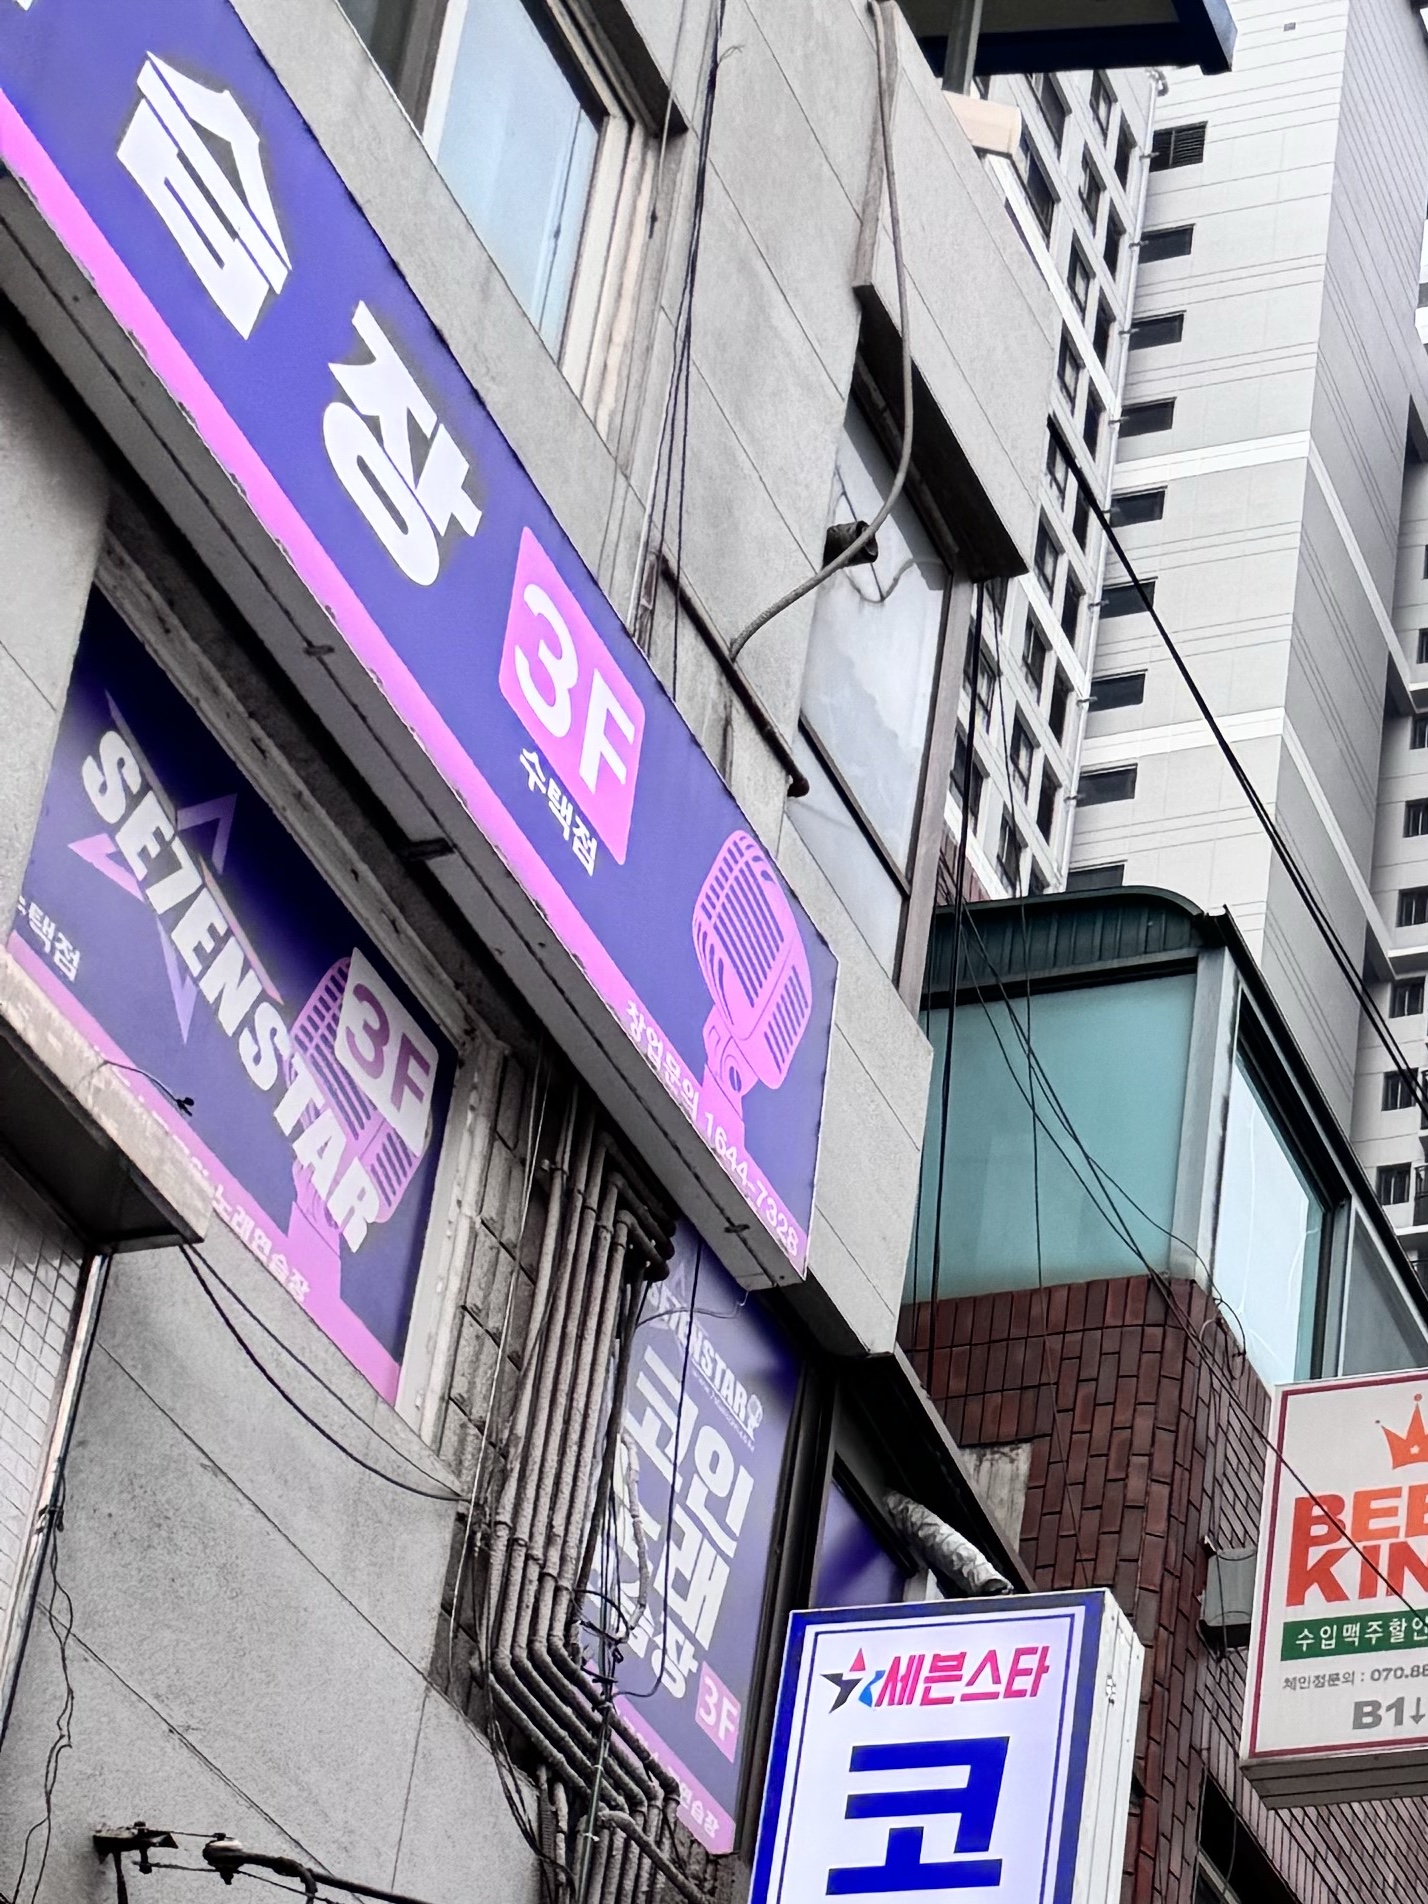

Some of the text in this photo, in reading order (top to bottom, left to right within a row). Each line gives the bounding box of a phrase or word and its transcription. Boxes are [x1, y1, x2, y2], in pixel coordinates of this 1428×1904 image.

[14, 0, 482, 586] 습장
[515, 583, 635, 793] 3F
[519, 747, 597, 876] 수택점
[344, 982, 432, 1118] 3F
[624, 998, 800, 1258] 창업문의 1644-7328
[699, 1678, 738, 1743] 3F
[874, 1646, 1050, 1707] 세븐스타
[1352, 1696, 1406, 1730] B1
